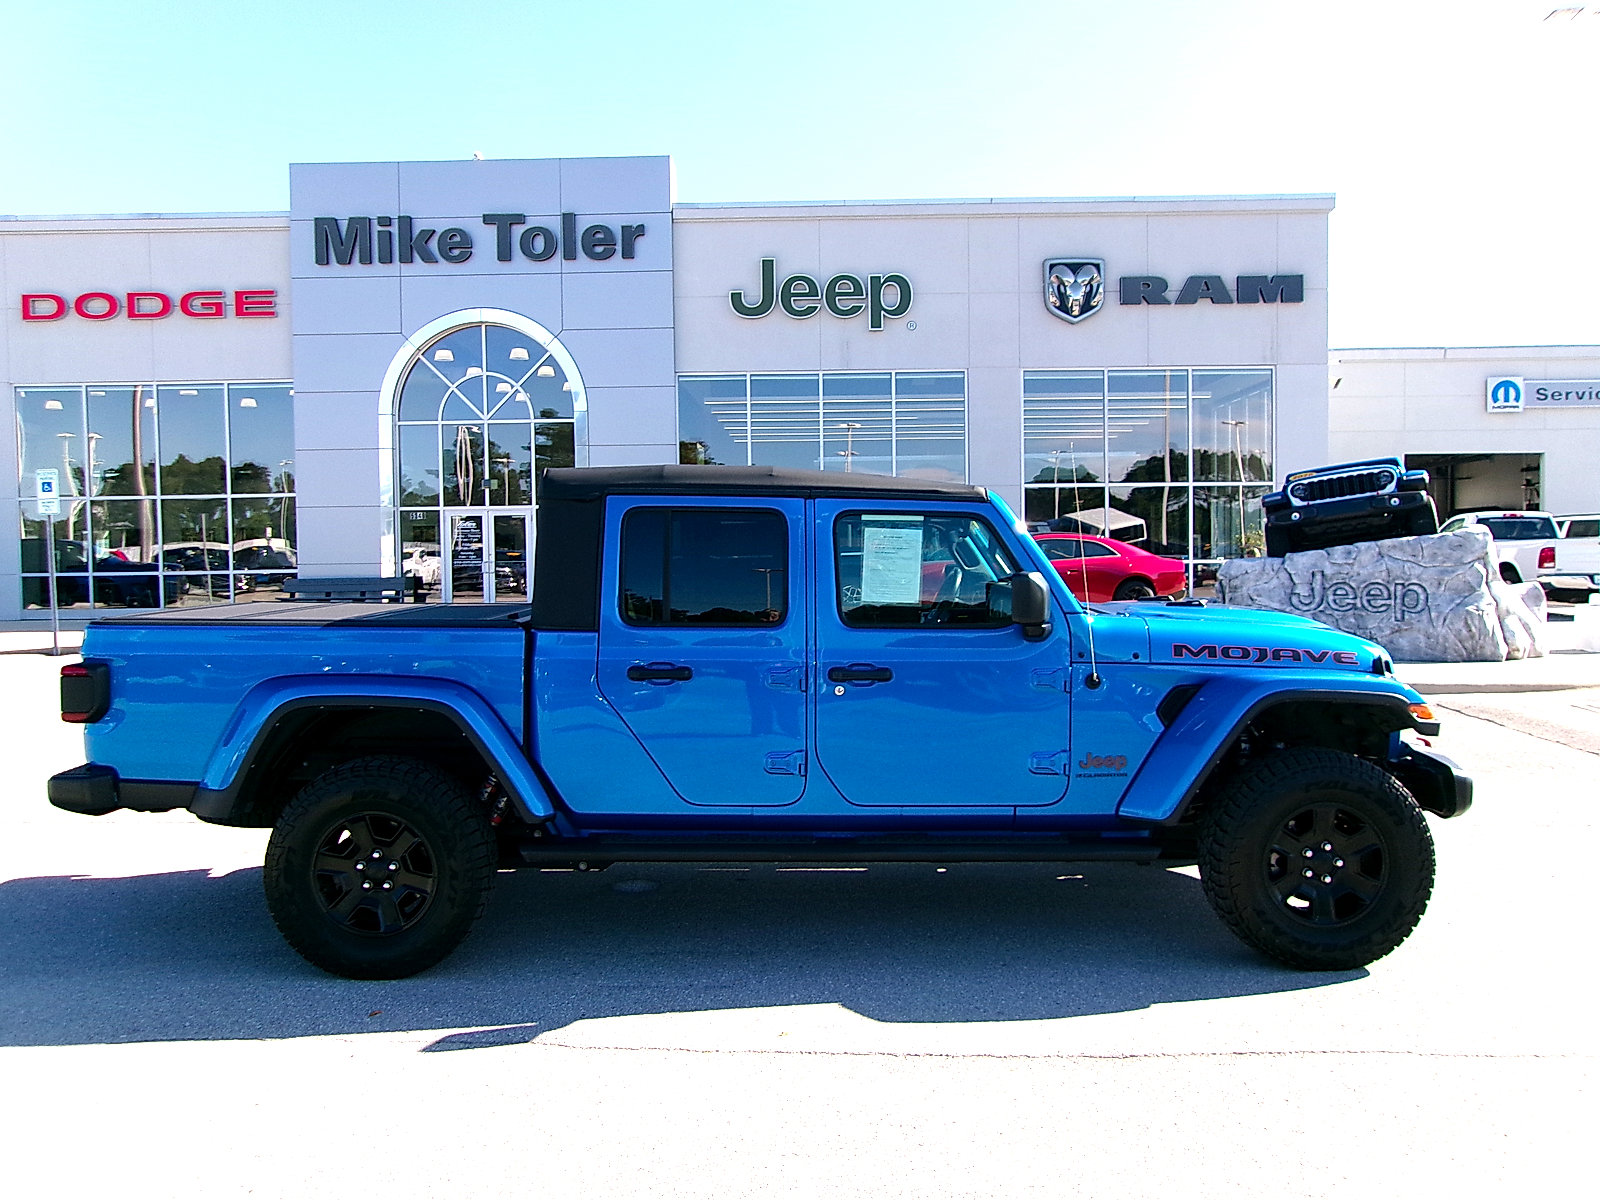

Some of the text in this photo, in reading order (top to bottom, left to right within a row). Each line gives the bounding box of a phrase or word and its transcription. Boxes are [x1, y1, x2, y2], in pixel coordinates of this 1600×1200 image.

[314, 212, 645, 265] Mike Toler
[729, 257, 914, 331] Jeep
[1119, 274, 1304, 305] RAM
[21, 290, 277, 321] DODGE
[1290, 570, 1429, 622] Jeep
[1173, 643, 1360, 666] MOJAVE
[1079, 752, 1127, 771] Jeep
